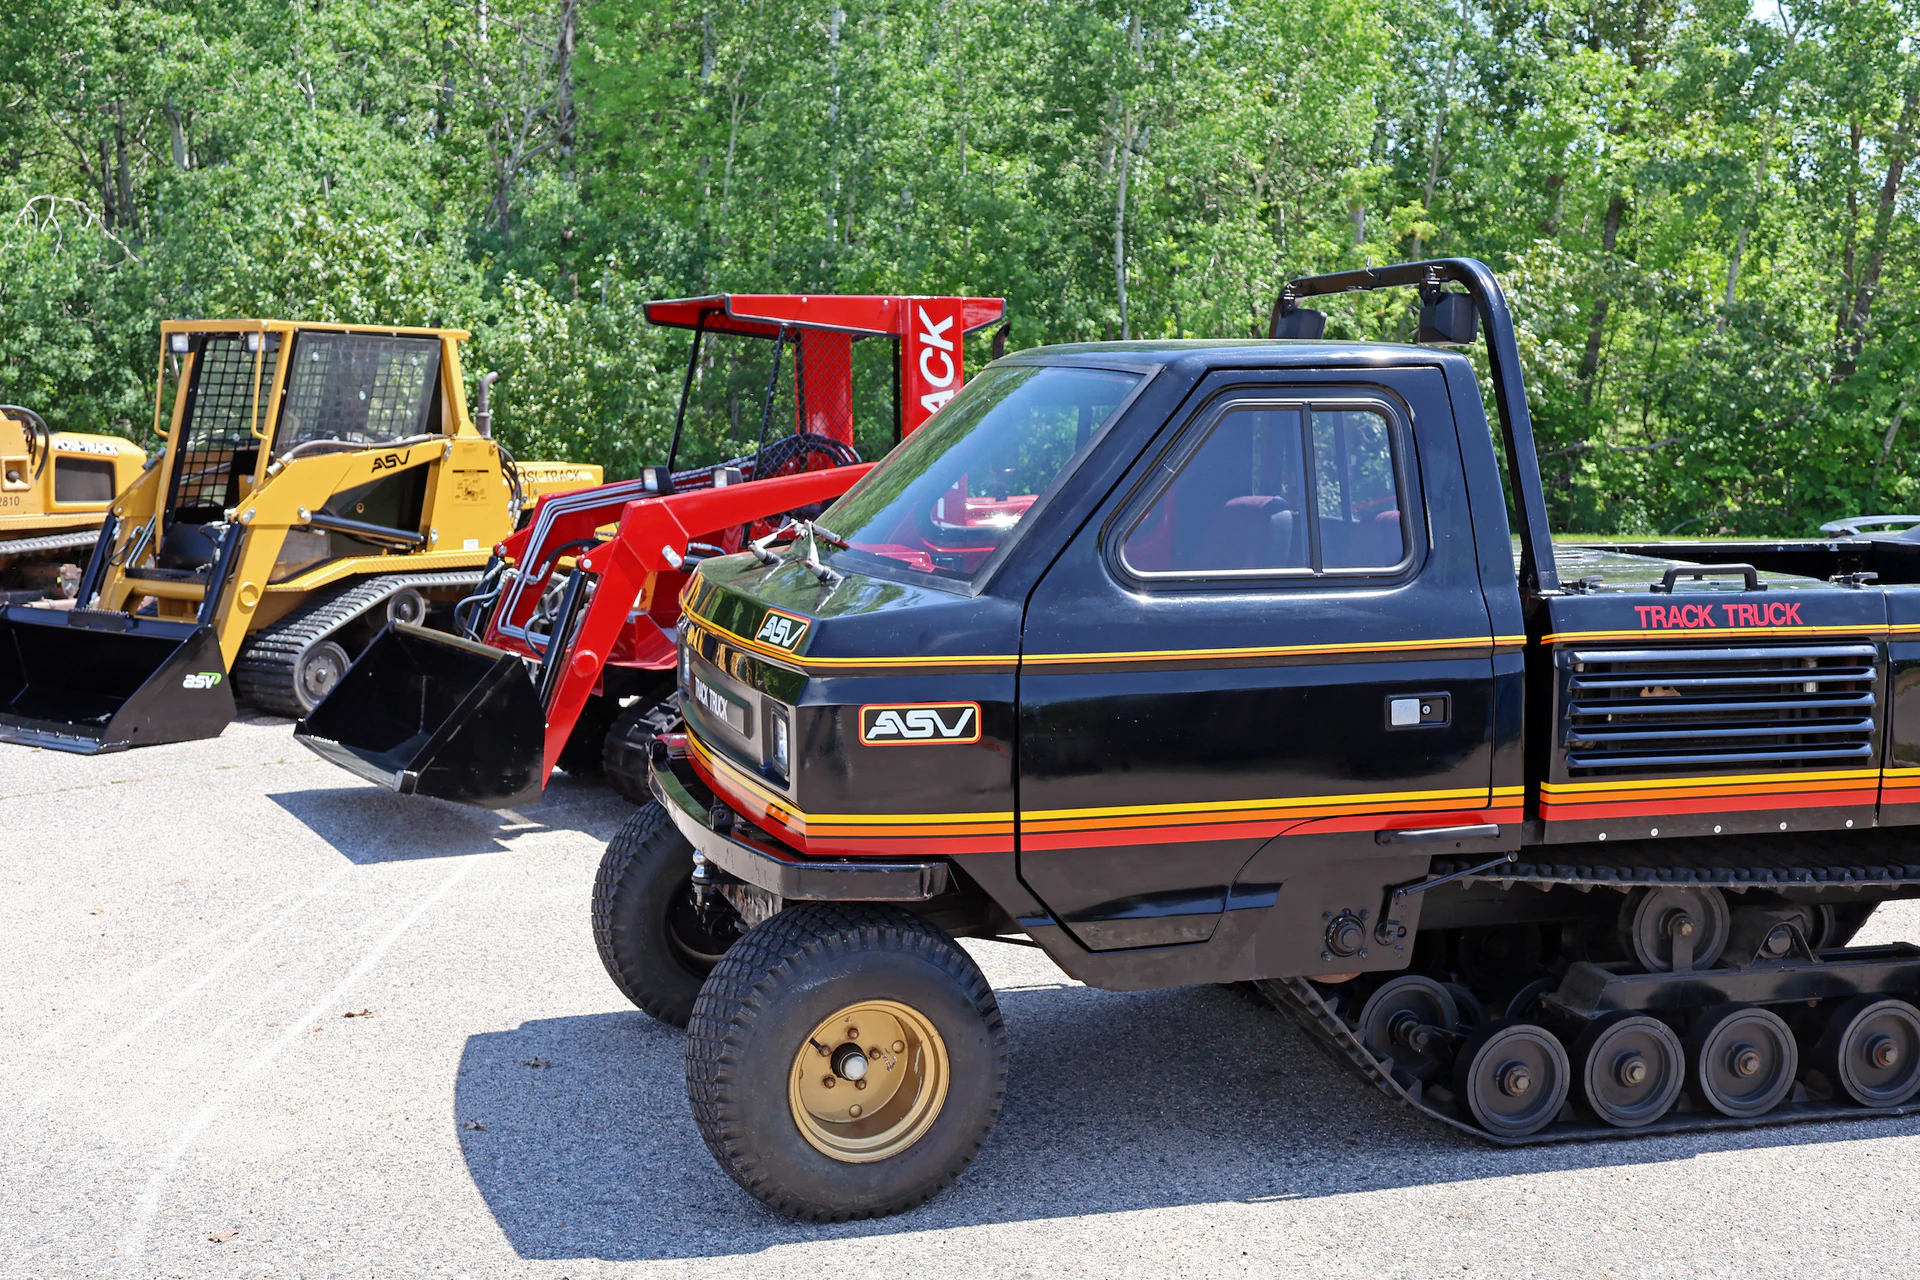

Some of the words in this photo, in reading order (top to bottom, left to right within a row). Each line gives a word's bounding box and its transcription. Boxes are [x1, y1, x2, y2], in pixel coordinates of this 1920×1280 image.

[918, 304, 955, 415] ACK
[53, 439, 119, 455] POSI-TRACK
[371, 449, 411, 473] ASV
[518, 469, 583, 484] OSI-TRACK
[1634, 605, 1716, 628] TRACK
[1722, 602, 1804, 626] TRUCK
[757, 615, 807, 647] ASV
[695, 676, 709, 708] TRACK
[709, 688, 728, 722] TRUCK
[866, 708, 974, 740] ASV
